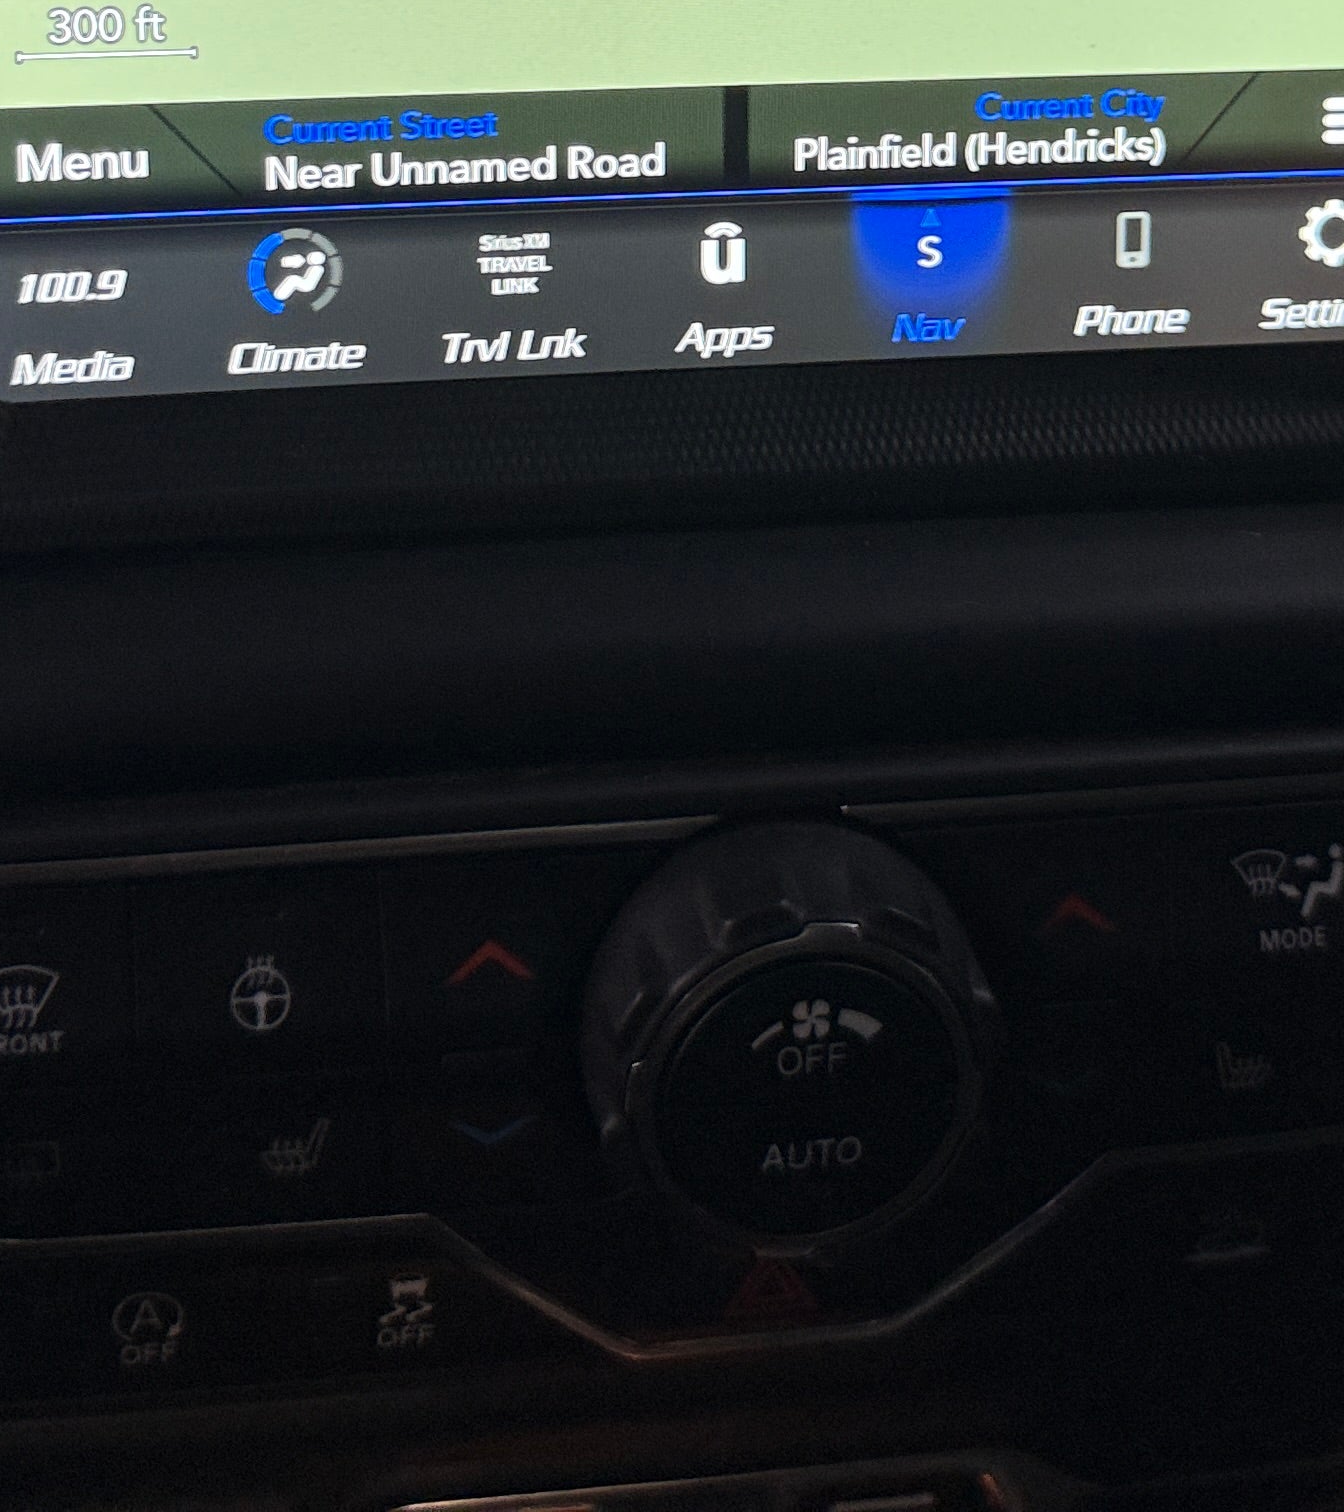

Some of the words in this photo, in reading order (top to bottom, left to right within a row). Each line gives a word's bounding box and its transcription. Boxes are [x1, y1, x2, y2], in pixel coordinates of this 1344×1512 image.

[47, 8, 124, 46] 300
[135, 5, 167, 42] ft
[975, 91, 1091, 123] Current
[1100, 88, 1166, 123] City
[264, 113, 392, 146] Current
[398, 110, 497, 141] Street
[16, 142, 149, 184] Menu
[265, 155, 357, 191] Near
[372, 146, 556, 187] Unnamed
[567, 142, 665, 179] Road
[793, 132, 956, 173] Plainfield
[964, 127, 1167, 173] (Hendricks)
[476, 255, 553, 274] TRAVEL
[916, 236, 944, 270] S
[18, 269, 127, 304] 100.9
[491, 277, 540, 296] LINK
[891, 313, 966, 345] Nav
[1073, 304, 1191, 338] Phone
[442, 330, 511, 364] Trvl
[517, 327, 587, 360] Lnk
[674, 322, 774, 359] Apps
[10, 350, 136, 387] Media
[228, 341, 367, 376] Climate
[1260, 927, 1326, 953] MODE
[777, 1043, 850, 1078] OFF
[762, 1138, 862, 1172] AUTO
[120, 1340, 176, 1366] OFF
[377, 1324, 434, 1348] OFF
